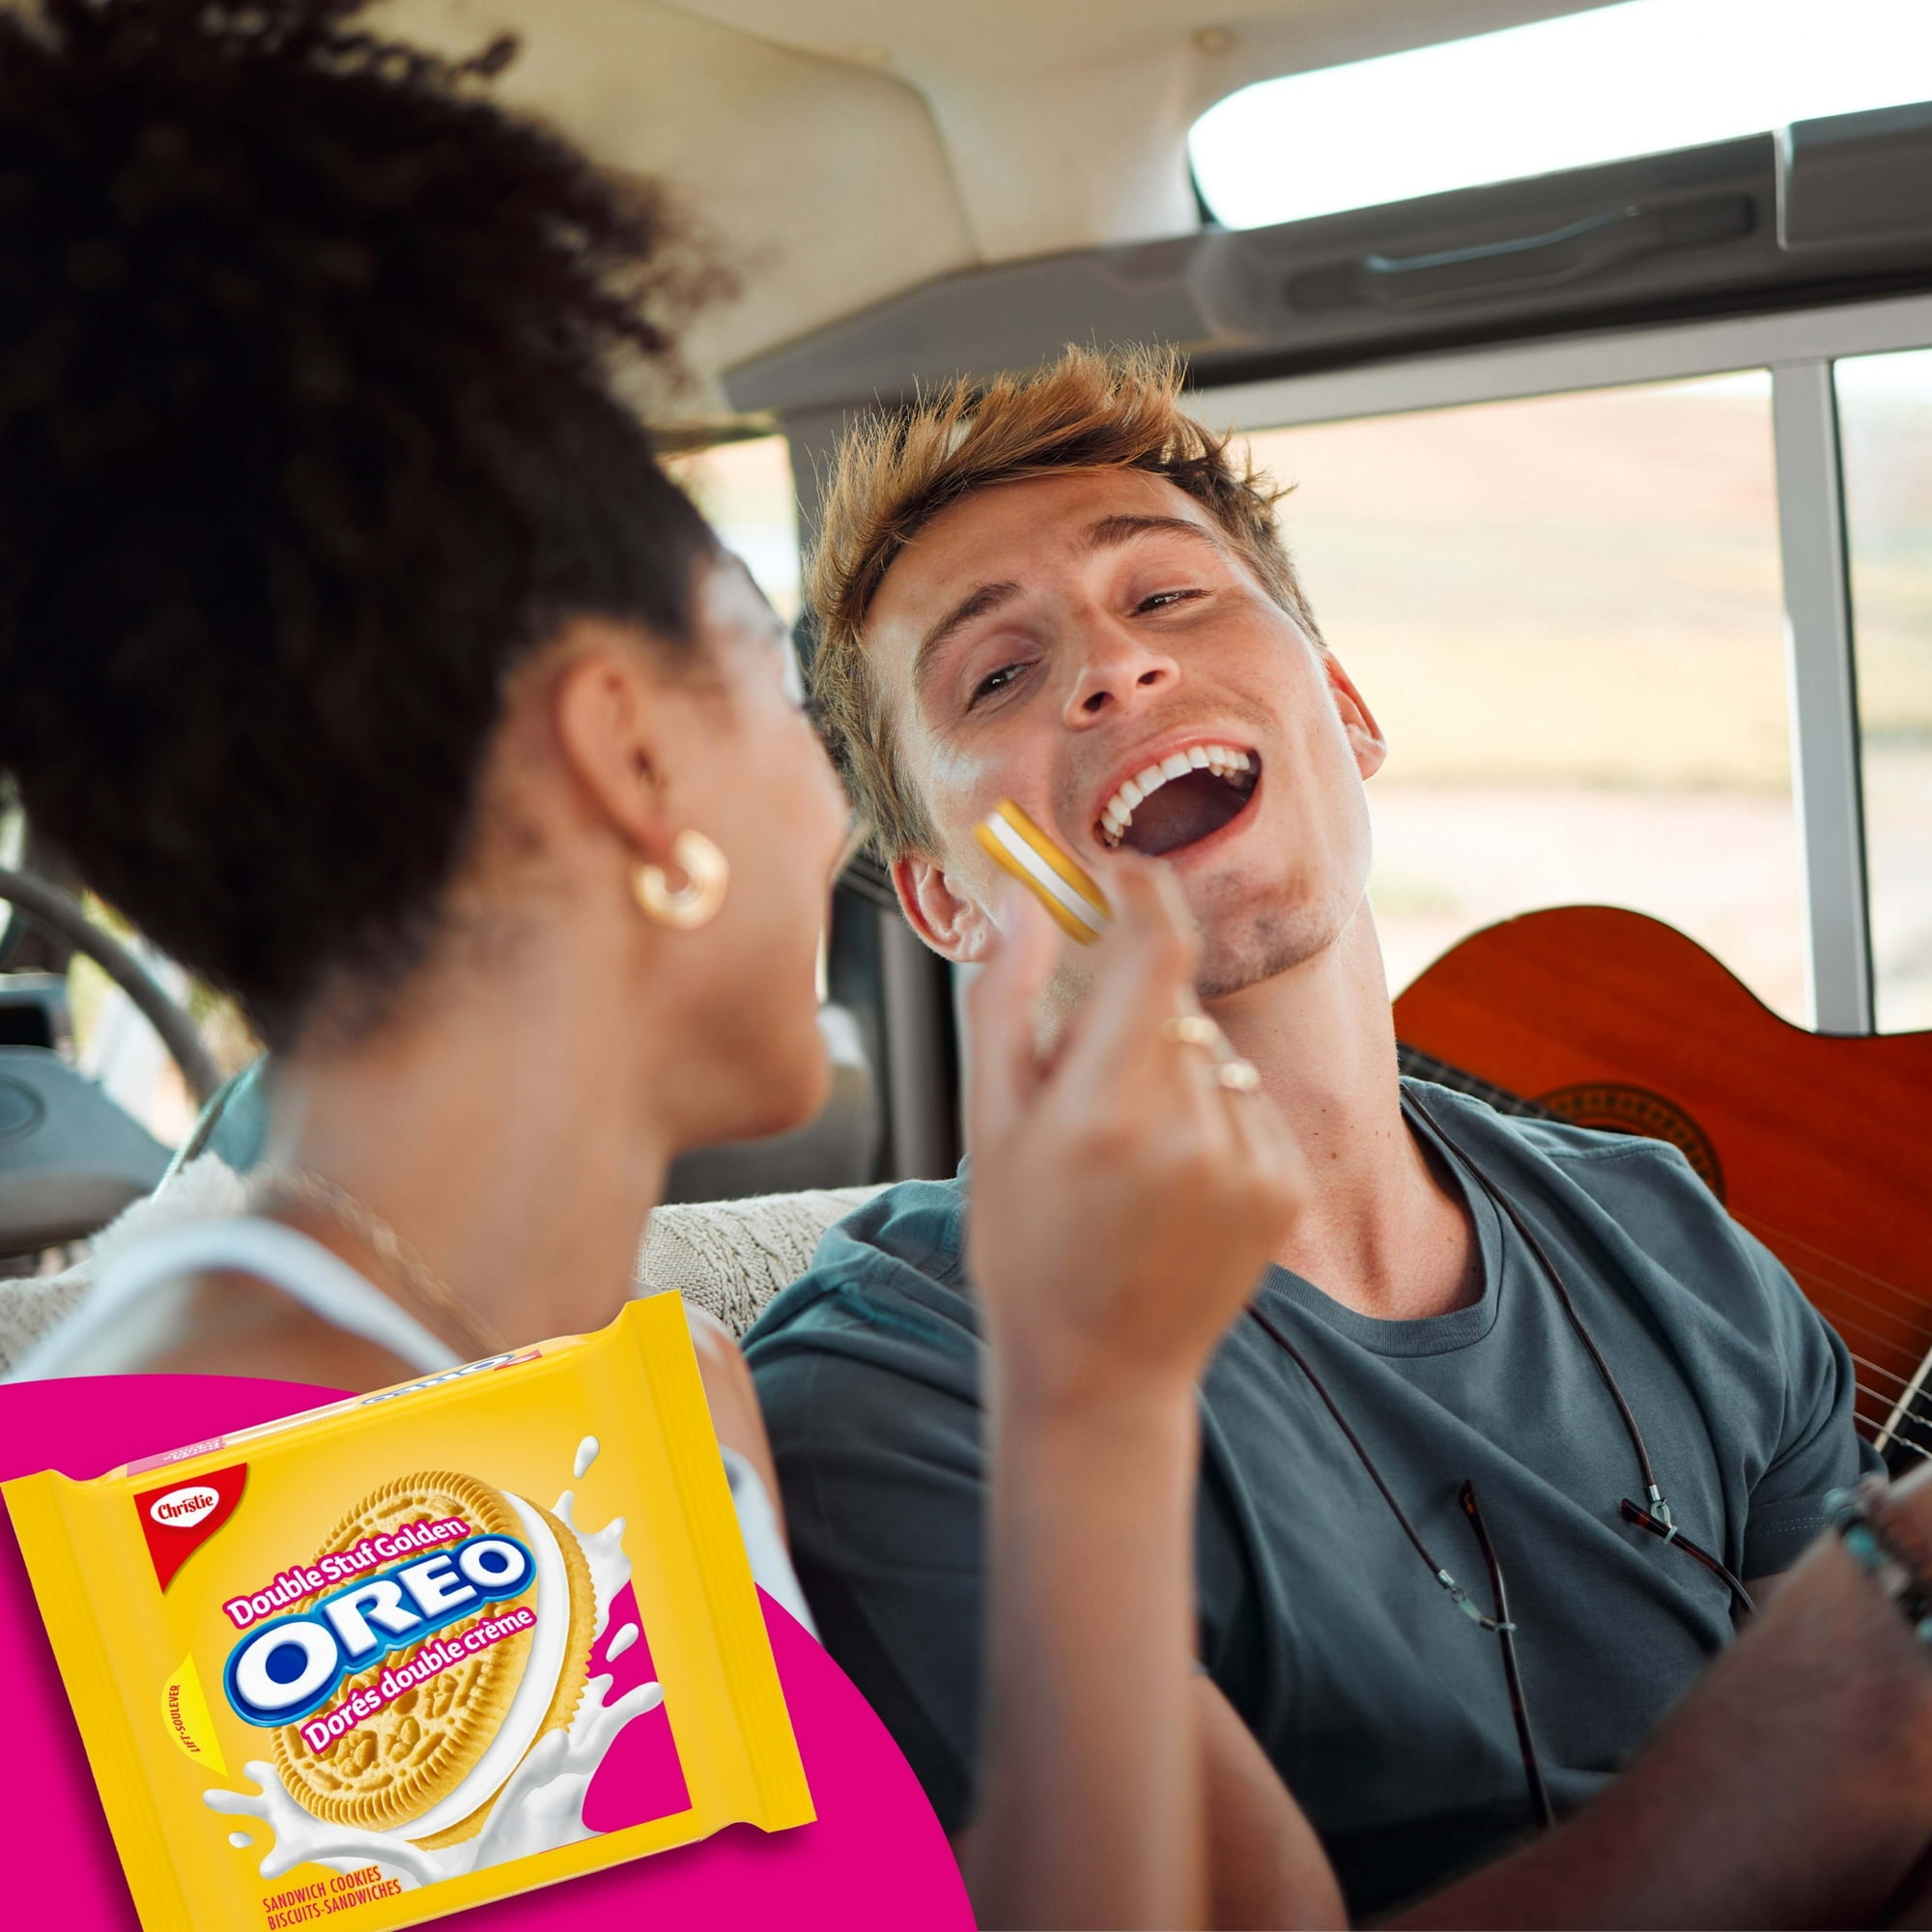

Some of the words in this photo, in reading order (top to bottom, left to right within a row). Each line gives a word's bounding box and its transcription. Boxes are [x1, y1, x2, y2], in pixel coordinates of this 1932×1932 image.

[157, 1494, 213, 1520] Christie
[227, 1569, 325, 1625] Double
[320, 1543, 377, 1580] Stuf
[375, 1520, 467, 1557] Golden
[236, 1540, 526, 1710] OREO
[304, 1691, 382, 1750] Dorés
[381, 1642, 465, 1698] double
[464, 1609, 532, 1648] crème
[263, 1882, 327, 1913] SANDWICH
[329, 1865, 382, 1893] COOKIES
[267, 1879, 402, 1931] BISCUITS-SANDWICHES
